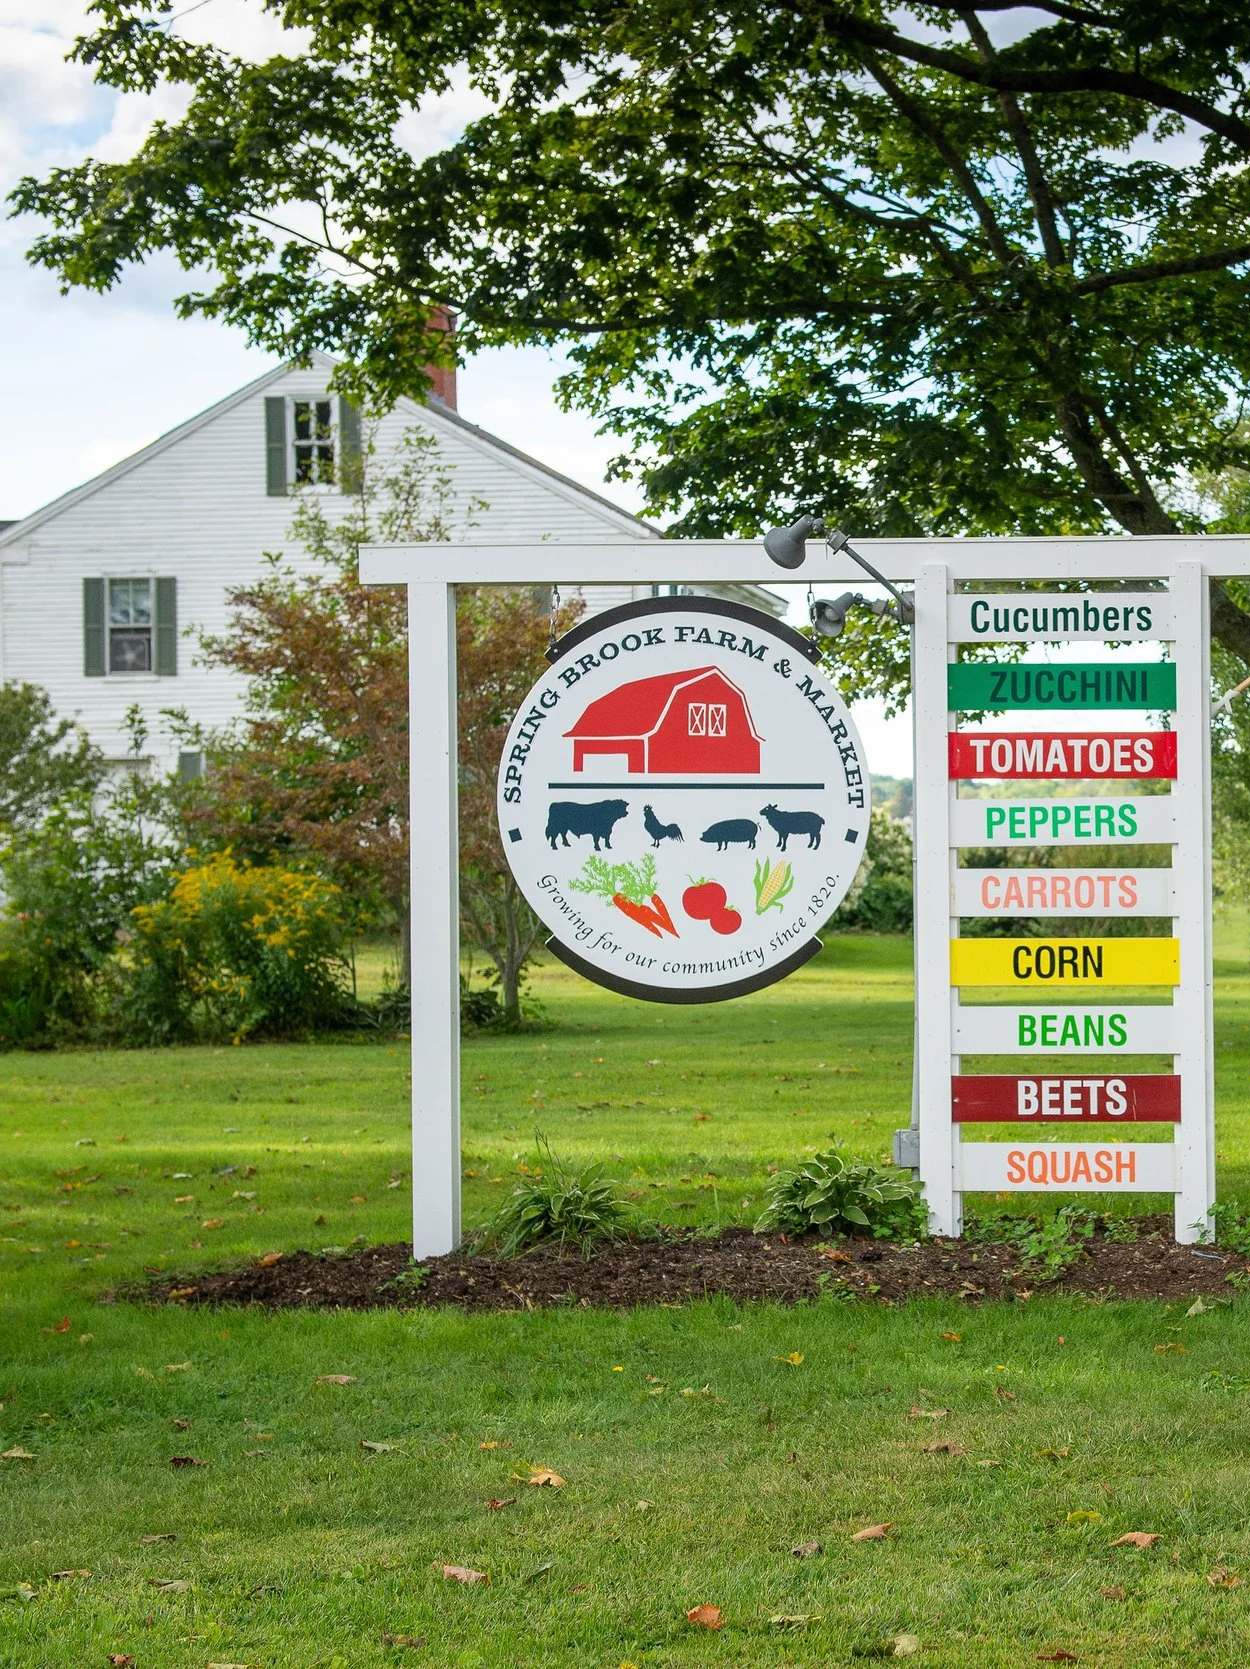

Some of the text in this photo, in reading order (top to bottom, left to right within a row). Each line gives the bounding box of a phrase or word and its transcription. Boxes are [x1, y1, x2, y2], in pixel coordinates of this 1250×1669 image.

[970, 600, 1153, 633] Cucumbers
[989, 670, 1148, 703] ZUCCHINI
[504, 626, 864, 809] SPRING BROOK FARM & MARKET
[969, 738, 1154, 773] TOMATOES
[985, 804, 1138, 839] PEPPERS
[981, 876, 1138, 909] CARROTS
[536, 873, 840, 975] Growing for our community since 1820.
[1012, 945, 1104, 978] CORN
[1018, 1014, 1127, 1047] BEANS
[1017, 1080, 1127, 1116] BEETS
[1007, 1150, 1136, 1184] SQUASH
